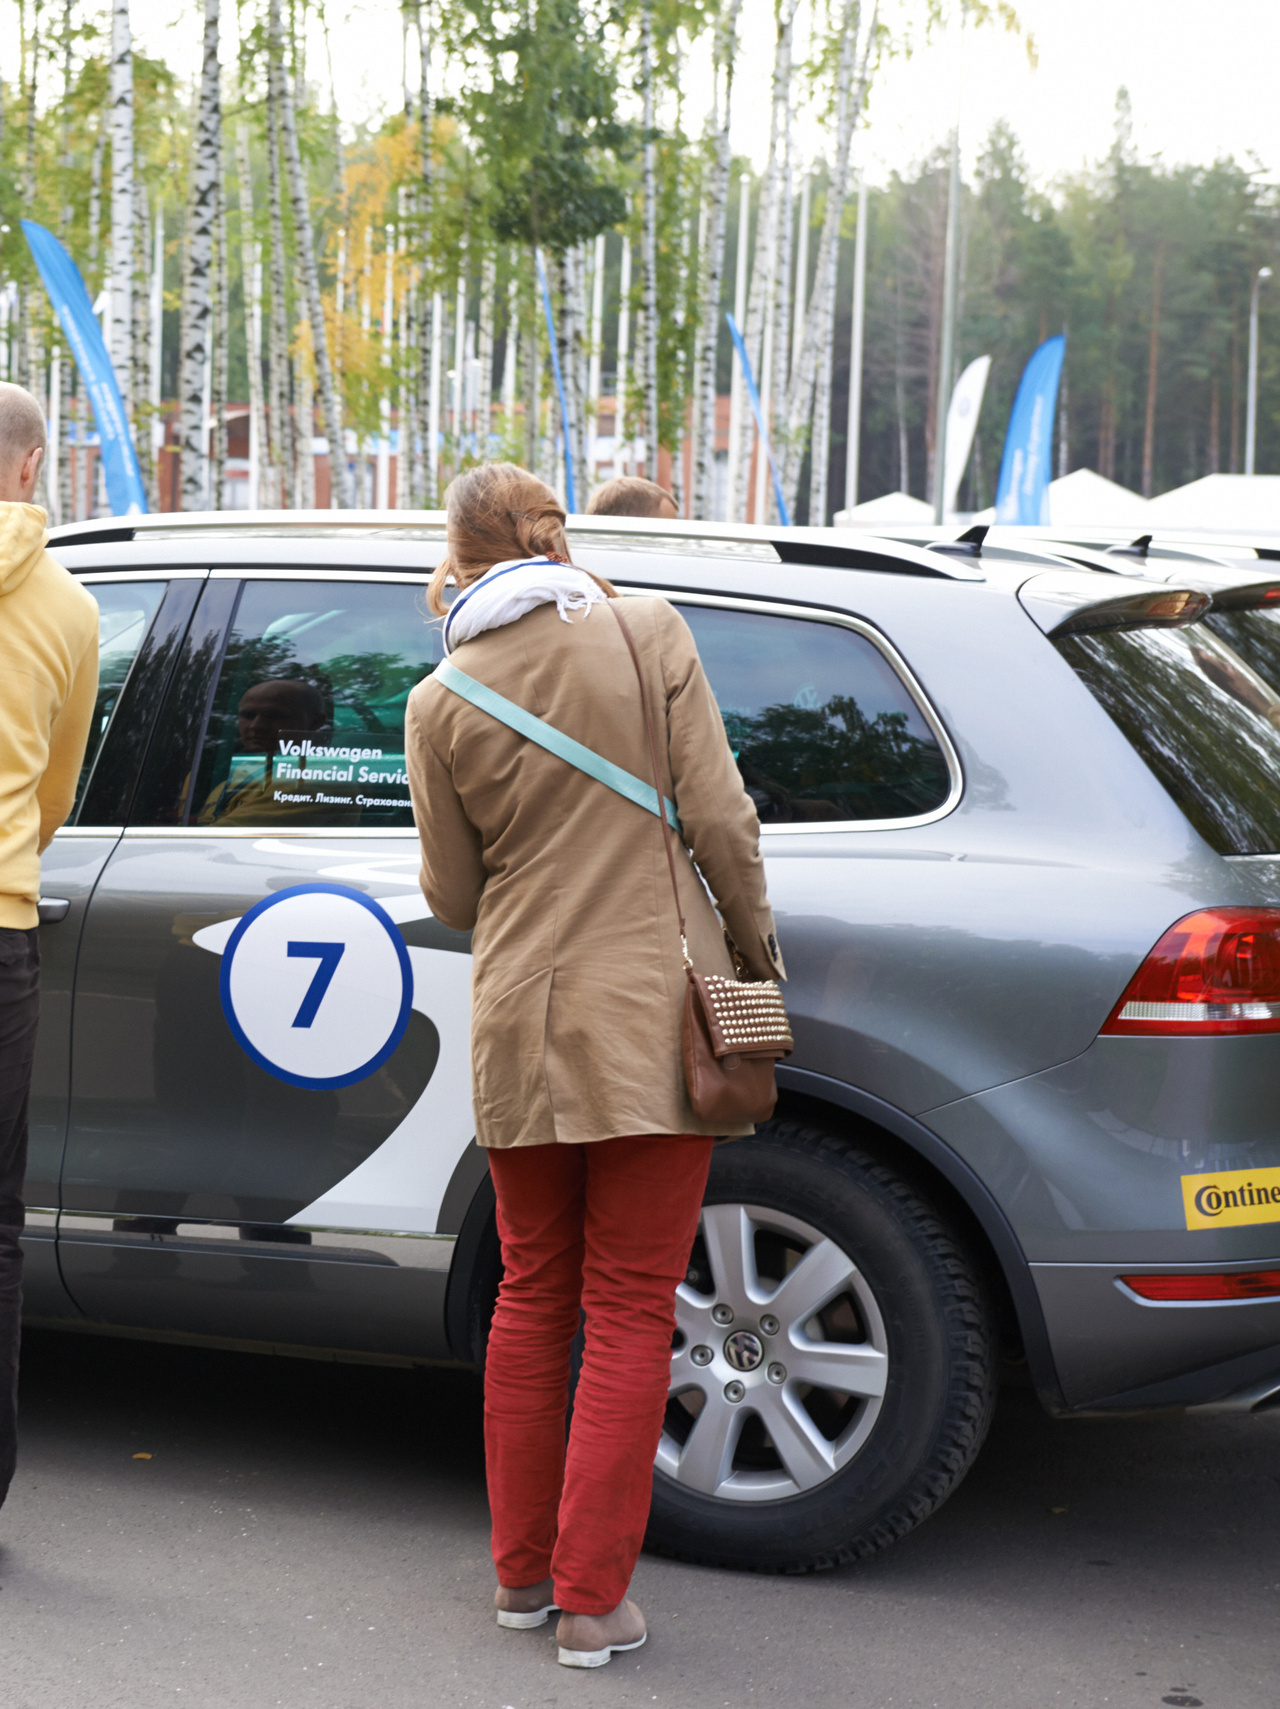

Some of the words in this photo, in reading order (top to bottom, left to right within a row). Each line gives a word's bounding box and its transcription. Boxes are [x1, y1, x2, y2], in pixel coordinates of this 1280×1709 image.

[278, 739, 382, 763] Volkswagen
[276, 763, 354, 782] Financial
[273, 790, 313, 803] Кредит.
[315, 793, 354, 805] Лизинг.
[287, 941, 345, 1029] 7
[1194, 1182, 1280, 1217] Contine
